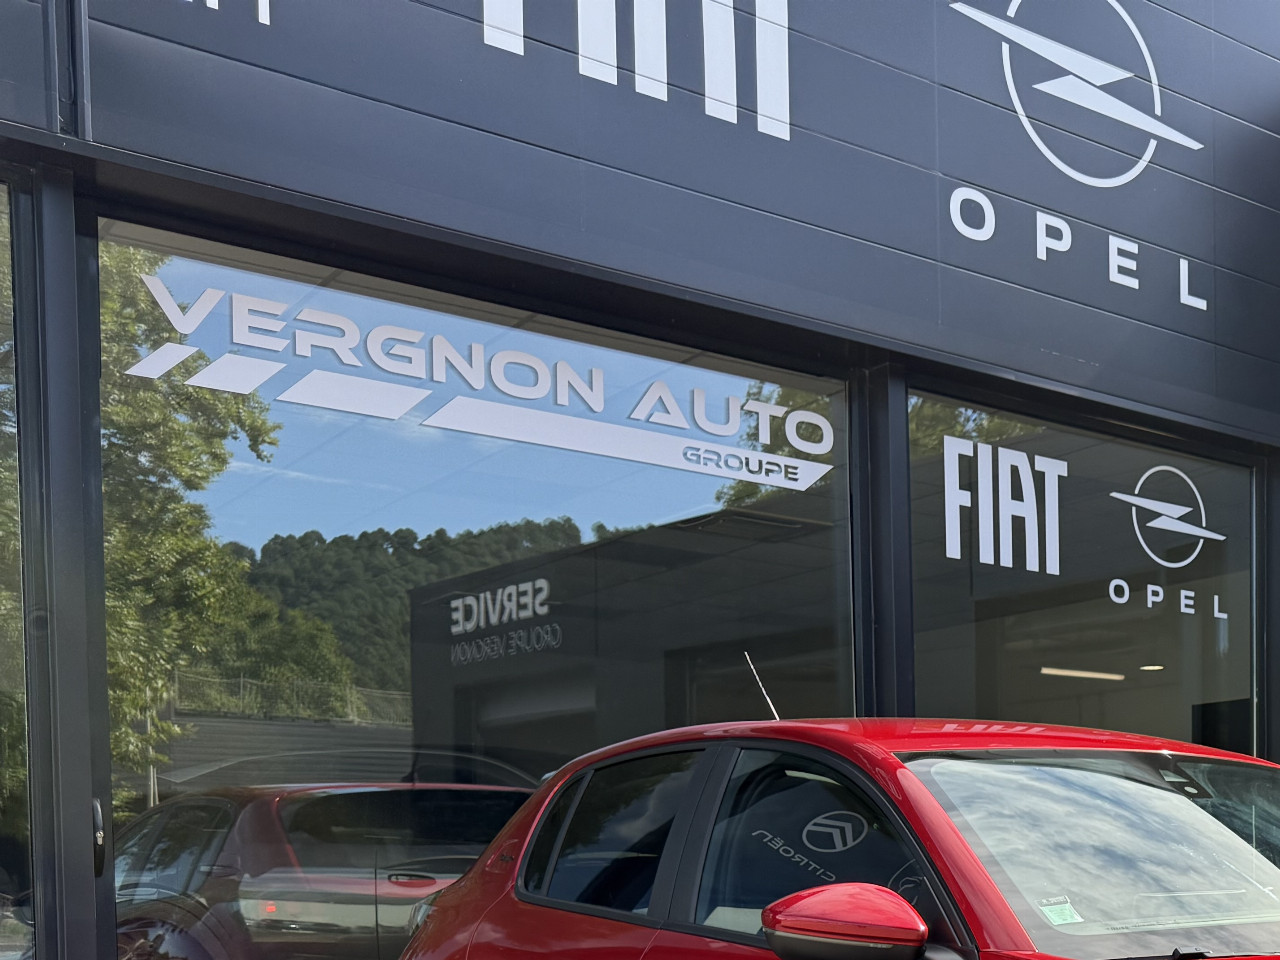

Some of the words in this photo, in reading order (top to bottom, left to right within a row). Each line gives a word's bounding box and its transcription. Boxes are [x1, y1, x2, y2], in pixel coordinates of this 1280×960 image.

[949, 187, 1208, 311] OPEL
[141, 274, 605, 414] VERGNON
[629, 379, 836, 457] AUTO
[682, 446, 800, 482] GROUPE
[943, 435, 1068, 576] FIAT
[1109, 578, 1228, 620] OPEL
